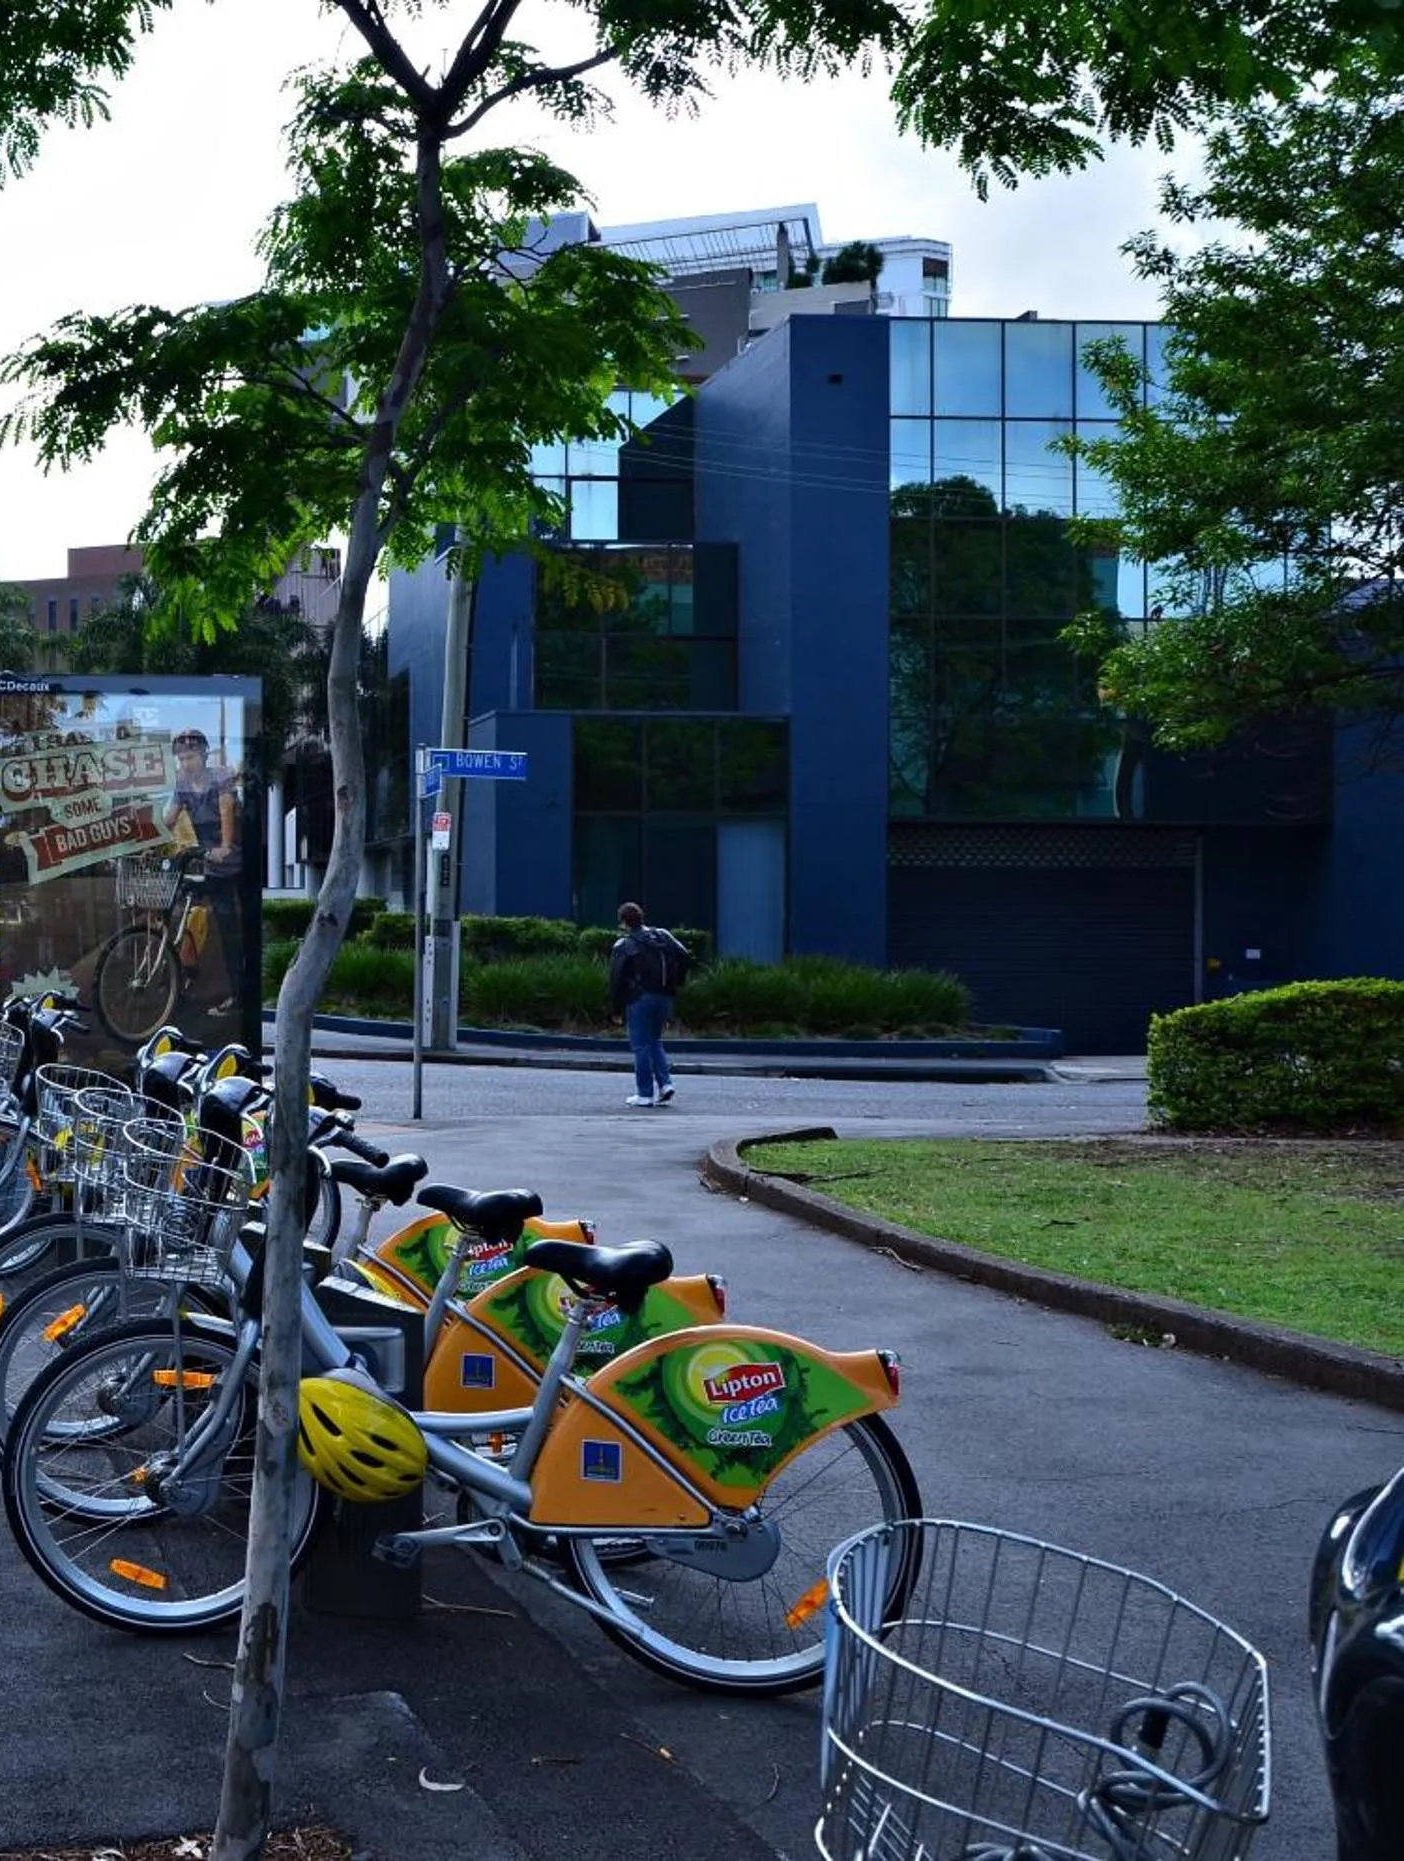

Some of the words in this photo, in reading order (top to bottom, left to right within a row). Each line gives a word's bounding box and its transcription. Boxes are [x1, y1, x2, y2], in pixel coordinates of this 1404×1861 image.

[2, 745, 166, 800] CHASE
[455, 752, 501, 769] BOWEN
[63, 797, 102, 820] SOME
[55, 827, 88, 853] BAD
[90, 815, 133, 842] GUYS
[708, 1371, 777, 1398] Lipton
[722, 1405, 747, 1424] Ice
[746, 1396, 779, 1417] Tea
